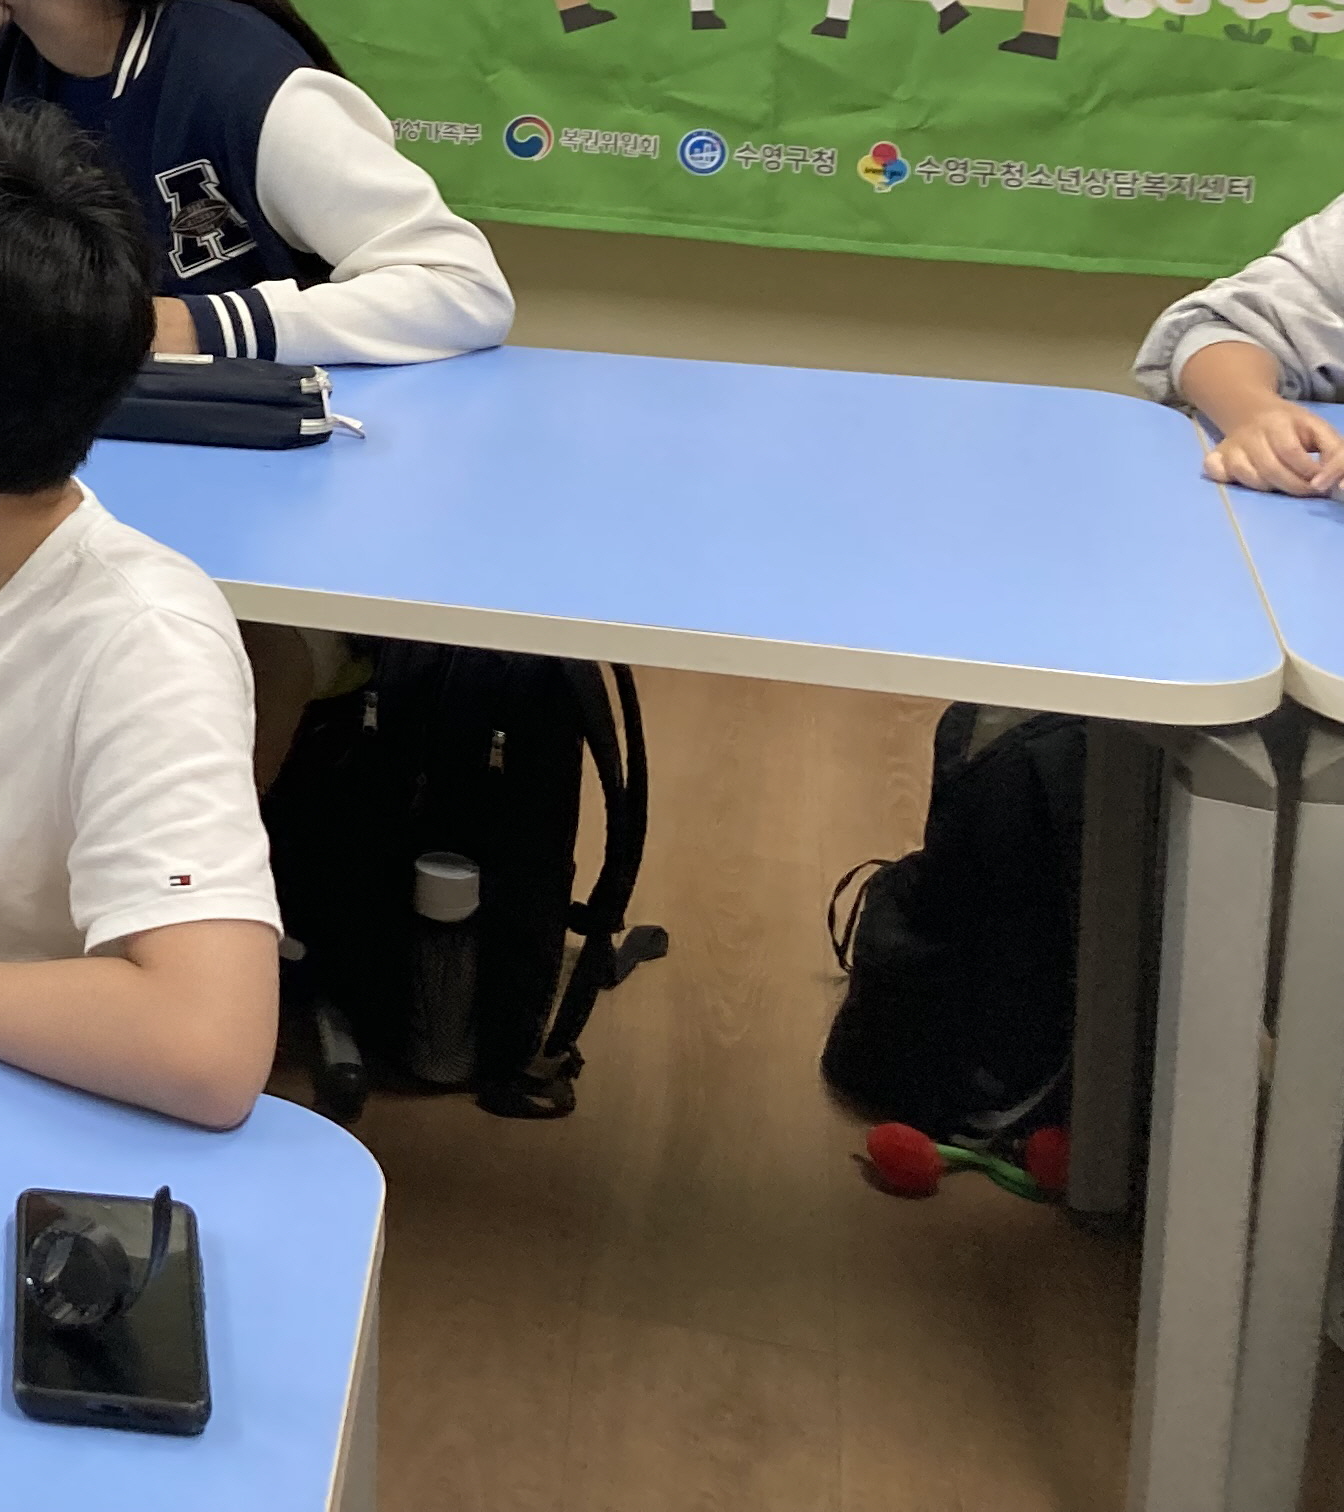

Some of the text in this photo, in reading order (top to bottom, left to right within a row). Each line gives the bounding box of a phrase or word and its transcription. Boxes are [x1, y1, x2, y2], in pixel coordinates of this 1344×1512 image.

[560, 127, 660, 159] 복권위원회
[733, 141, 838, 176] 수영구청
[915, 155, 1255, 203] 수영구청소년상담복지센터
